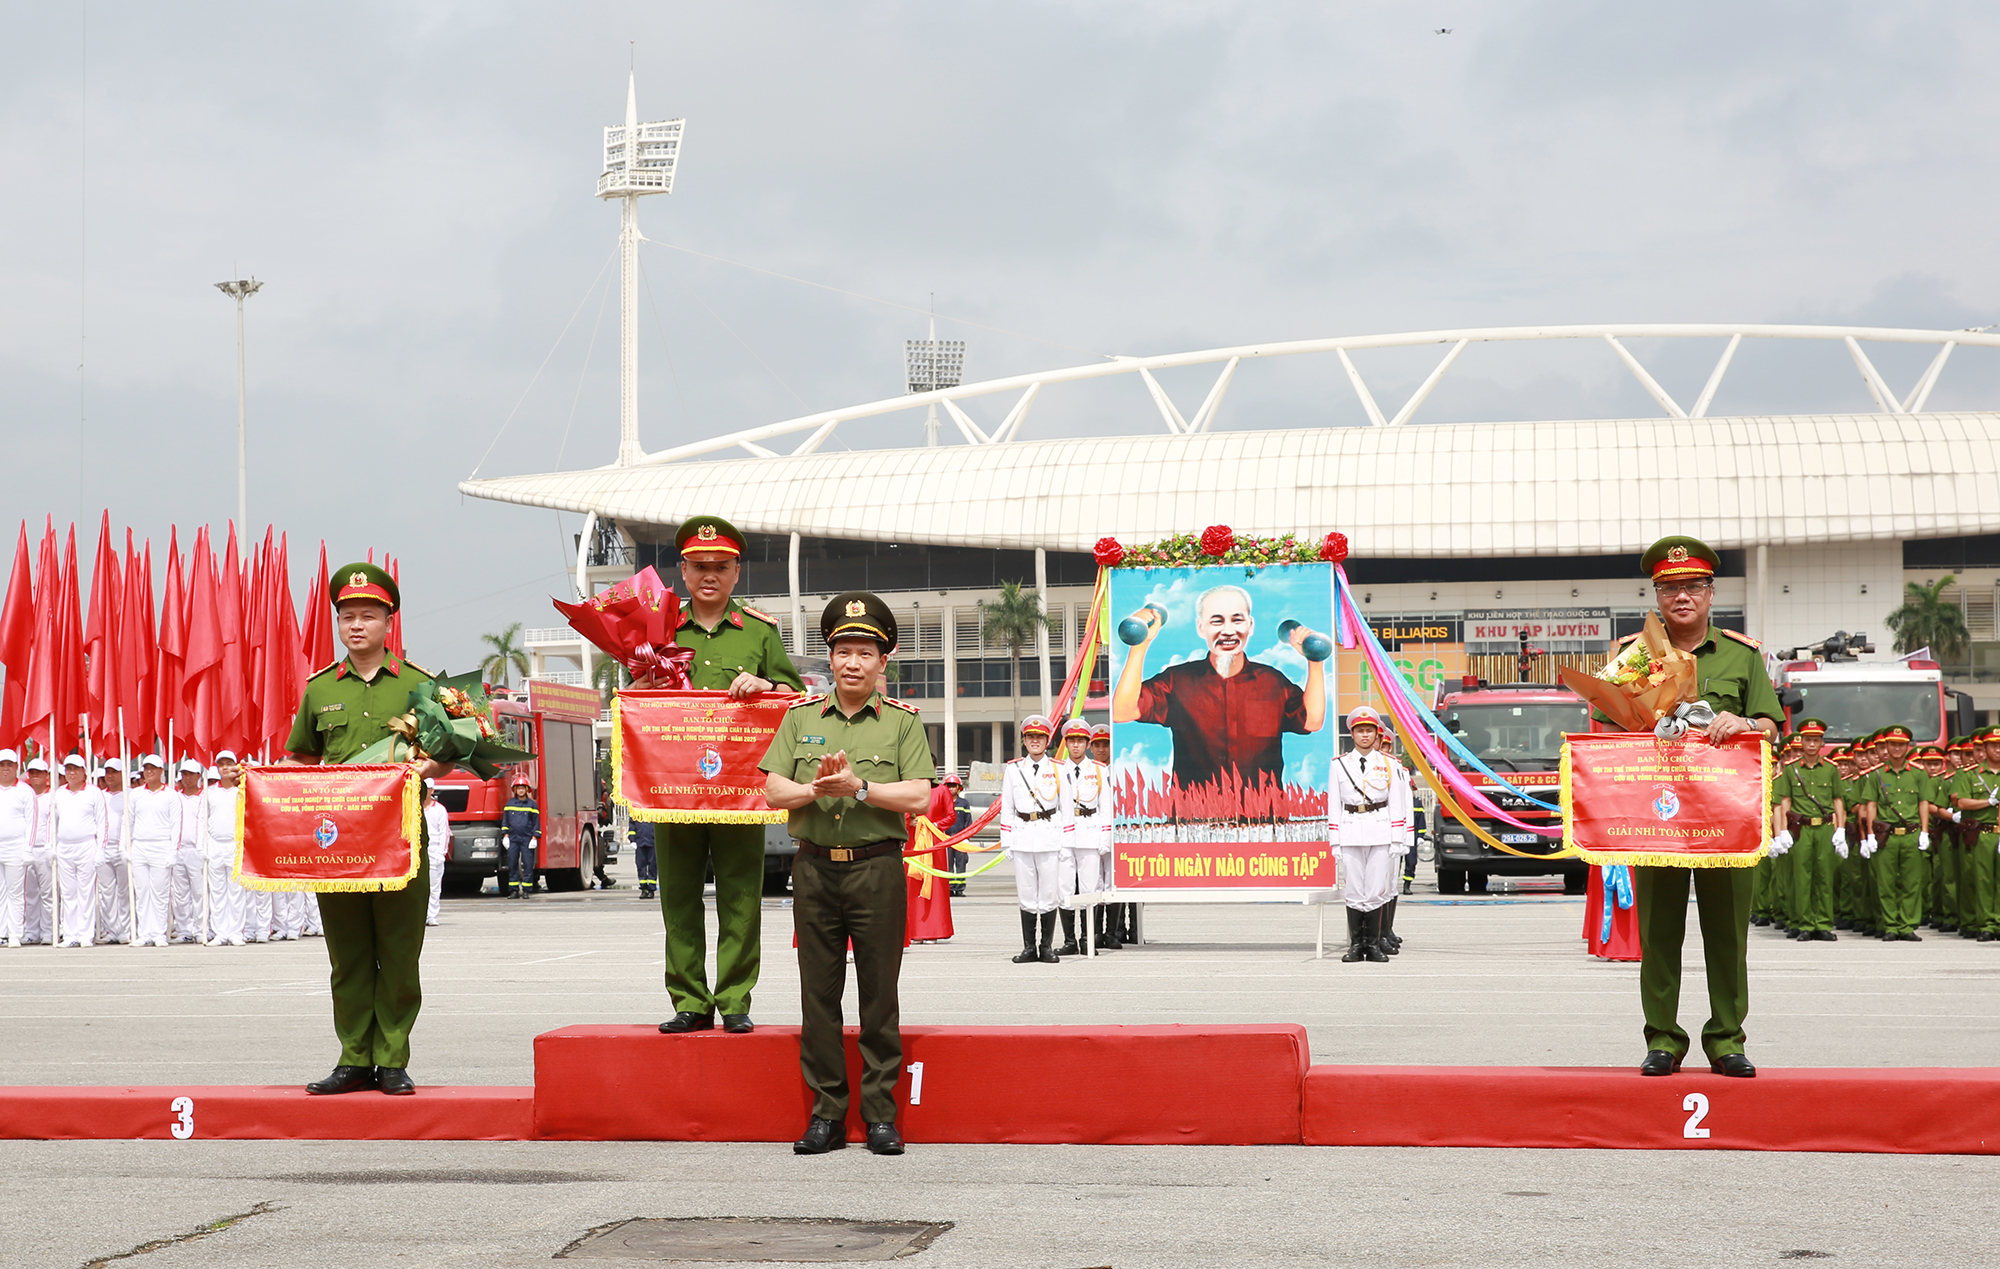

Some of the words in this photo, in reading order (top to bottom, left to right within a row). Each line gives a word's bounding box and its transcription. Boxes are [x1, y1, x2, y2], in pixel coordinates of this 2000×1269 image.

[1487, 610, 1504, 619] LIÊN
[1543, 610, 1563, 618] THAO
[1566, 608, 1590, 618] QUỐC
[1383, 626, 1448, 639] BILLIARDS
[1475, 626, 1506, 638] KHU
[714, 716, 736, 724] CHỨC
[980, 770, 996, 781] SÂN
[1507, 774, 1522, 784] SÁT
[1524, 776, 1535, 784] PC
[1537, 776, 1543, 784] &
[1546, 776, 1556, 784] CC
[319, 785, 330, 794] TỔ
[650, 784, 672, 794] GIẢI
[675, 783, 704, 794] NHẤT
[707, 784, 734, 795] TOÀN
[738, 786, 766, 796] ĐOÀN
[1607, 824, 1632, 836] GIẢI
[1635, 826, 1656, 836] NHÌ
[1658, 827, 1689, 837] TOÀN
[1692, 826, 1725, 837] ĐOÀN
[275, 853, 297, 864] GIẢI
[300, 856, 313, 864] BA
[315, 853, 344, 863] TOÀN
[346, 853, 376, 863] ĐOÀN
[1148, 853, 1170, 877] TÔI
[1174, 852, 1212, 877] NGÀY
[1215, 852, 1245, 877] NÀO
[1249, 853, 1288, 877] CŨNG
[907, 1061, 924, 1105] 1
[171, 1096, 194, 1139] 3
[1683, 1092, 1710, 1138] 2
